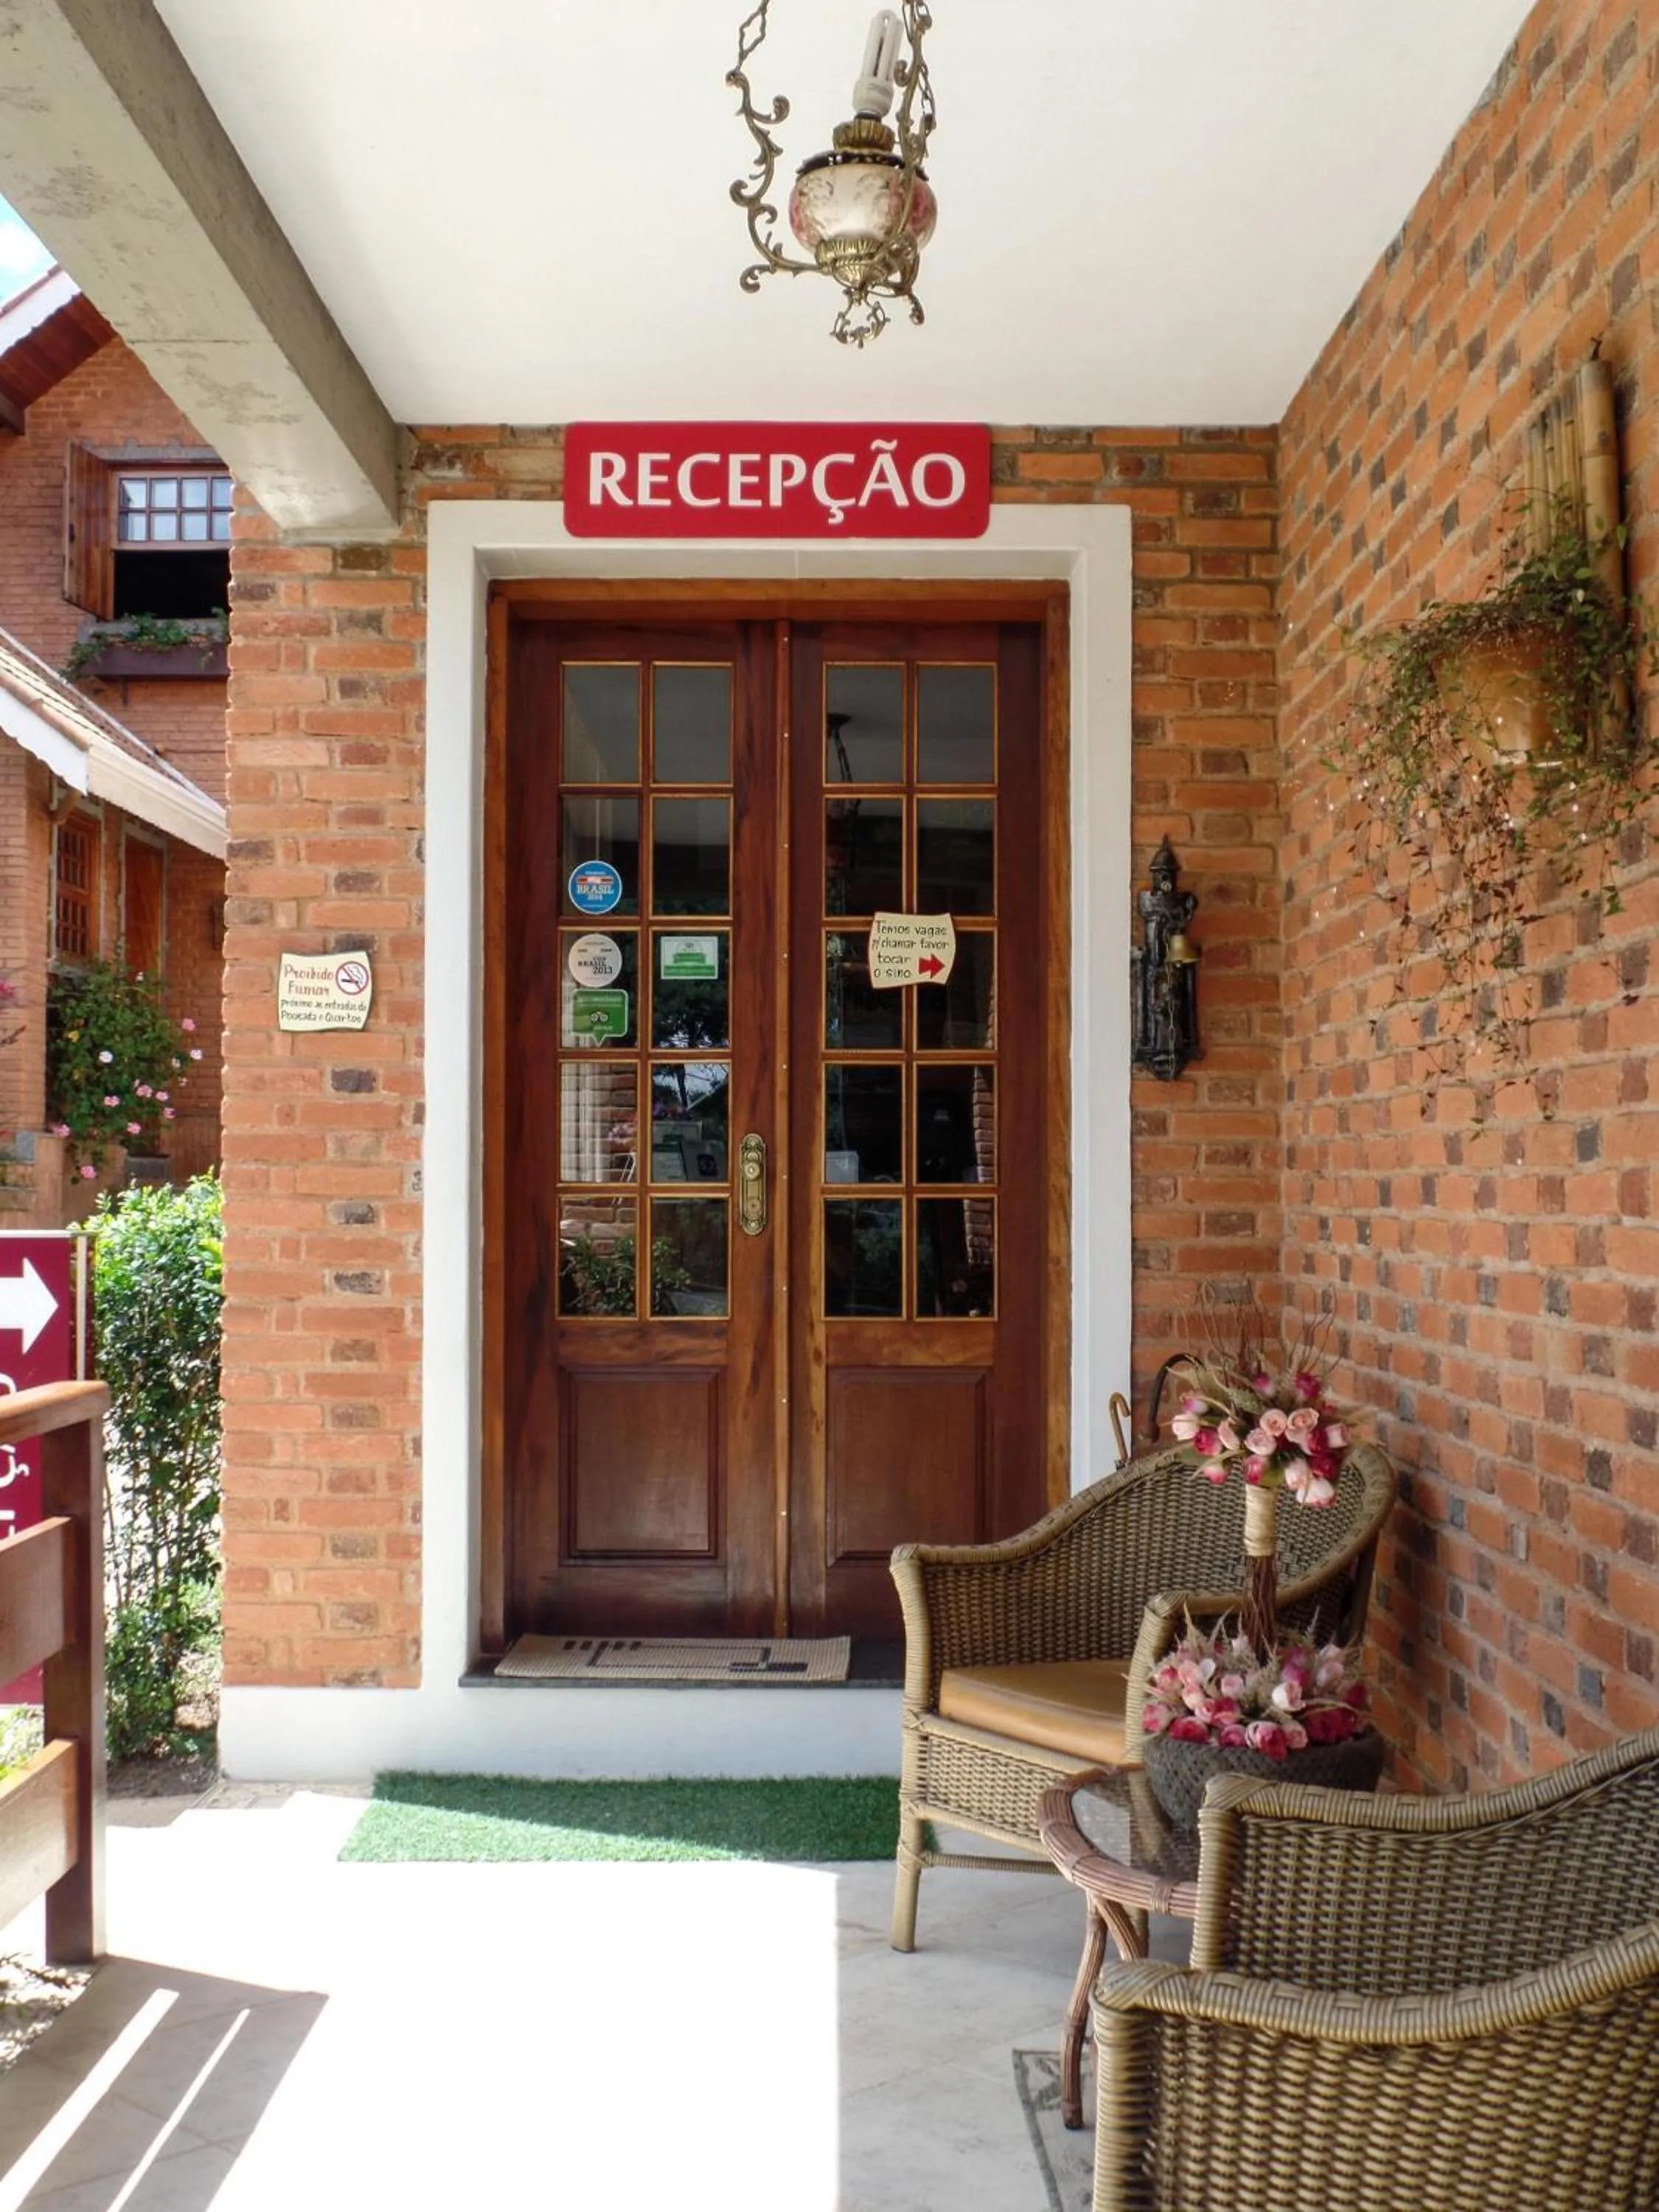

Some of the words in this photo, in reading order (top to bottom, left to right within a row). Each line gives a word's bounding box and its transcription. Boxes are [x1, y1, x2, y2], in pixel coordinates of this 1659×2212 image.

[589, 439, 966, 524] RECEPÇÃO
[874, 919, 911, 934] Temos
[914, 925, 947, 936] vagas
[920, 938, 949, 950] favor
[877, 952, 911, 964] tocar
[284, 963, 334, 981] Proibido
[886, 968, 911, 978] sino
[288, 980, 330, 996] Fumar
